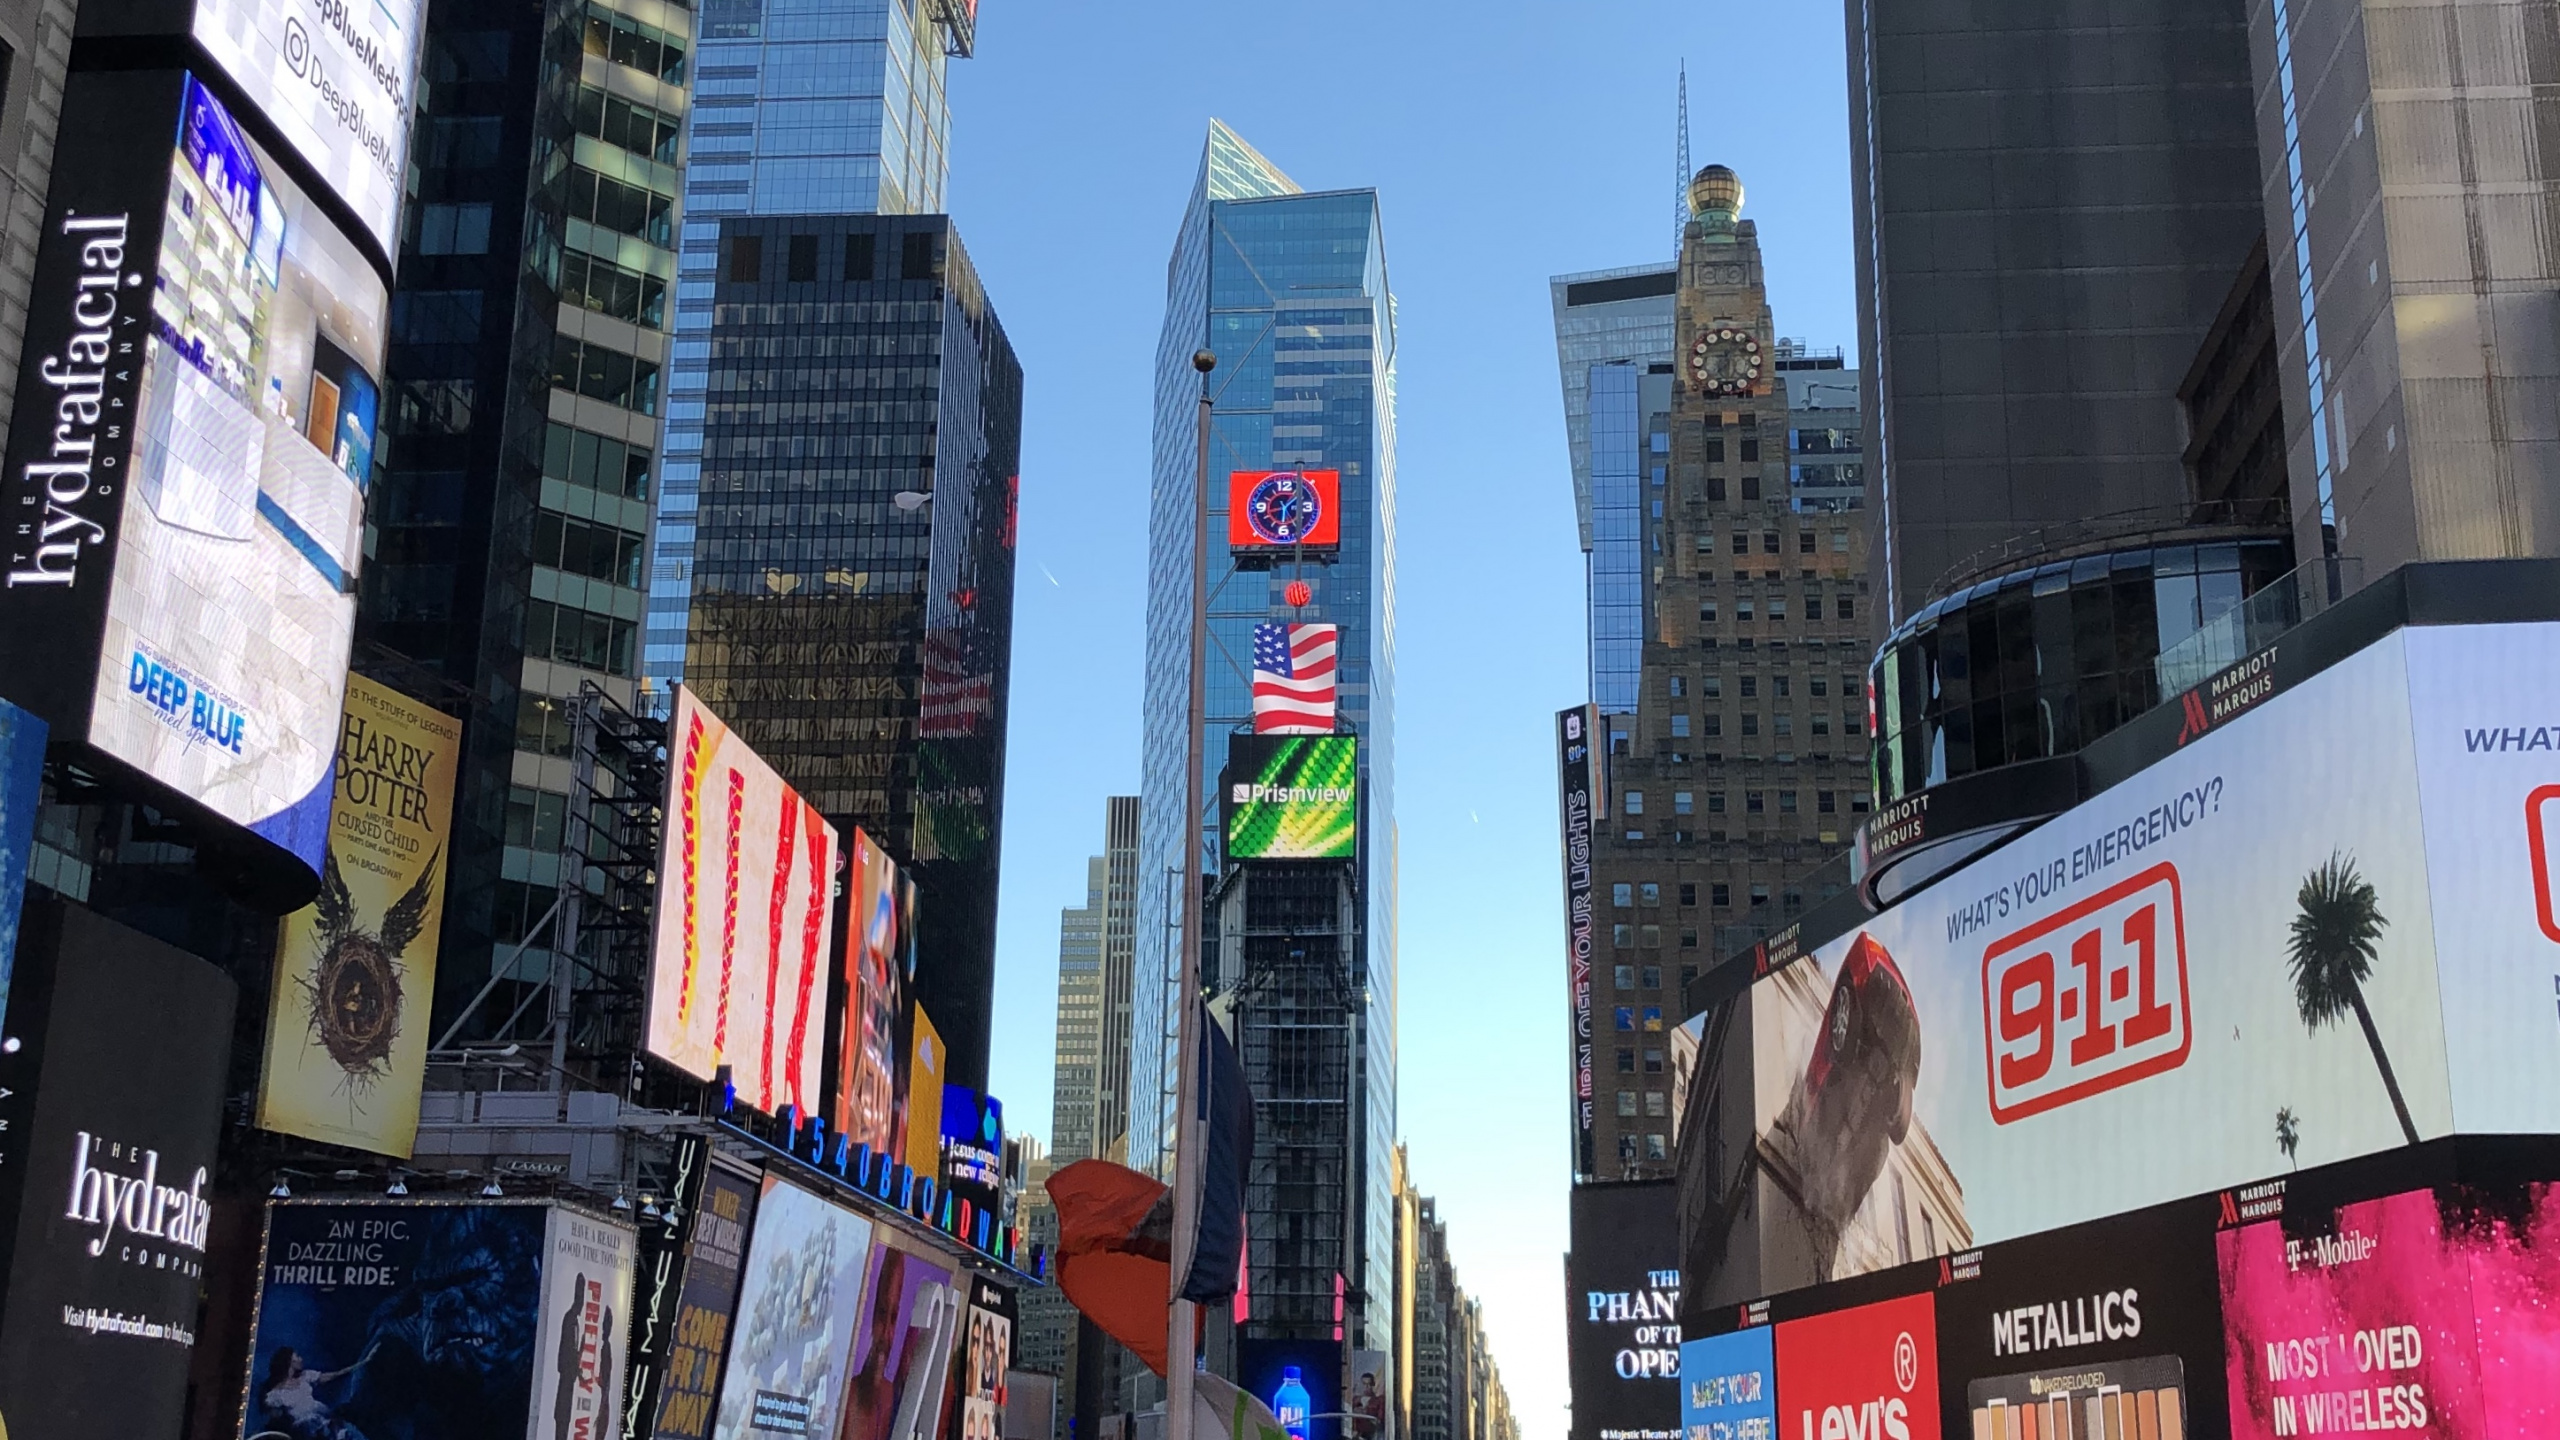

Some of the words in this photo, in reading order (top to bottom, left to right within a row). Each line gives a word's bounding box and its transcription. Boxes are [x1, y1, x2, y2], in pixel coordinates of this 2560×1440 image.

[7, 211, 142, 588] hydrafacial
[100, 316, 137, 495] COMPANY
[1277, 481, 1292, 491] 12
[1256, 502, 1266, 513] 9
[1303, 502, 1313, 512] 3
[13, 496, 36, 562] THE
[1279, 525, 1289, 535] 6
[2211, 645, 2278, 697] MARRIOTT
[129, 651, 187, 715] DEEP
[191, 689, 245, 755] BLUE
[361, 691, 378, 708] THE
[380, 700, 406, 717] STUFF
[407, 713, 418, 725] OF
[2212, 673, 2273, 720] MARQUIS
[153, 708, 190, 732] med
[182, 726, 208, 756] spa
[341, 712, 435, 788] HARRY
[333, 753, 433, 832] POTTER
[1251, 783, 1350, 803] Prismview
[1869, 794, 1930, 836] MARRIOTT
[337, 811, 381, 840] CURSED
[384, 829, 420, 854] CHILD
[1568, 789, 1591, 890] LIGHTS
[1870, 820, 1923, 857] MARQUIS
[346, 854, 359, 866] ON
[361, 858, 403, 881] BROADWAY
[1946, 886, 2010, 944] WHAT'S
[2013, 858, 2067, 910] YOUR
[2071, 775, 2224, 883] EMERGENCY?
[1573, 891, 1592, 979] YOUR
[1768, 923, 1800, 950] MARRIOTT
[1769, 942, 1798, 966] MARQUIS
[95, 1137, 138, 1162] THE
[511, 1161, 562, 1173] LAMAR
[955, 1162, 977, 1179] new
[2240, 1180, 2286, 1201] MARRIOTT
[879, 1151, 1020, 1265] BROADWAY
[2241, 1199, 2283, 1219] MARQUIS
[362, 1221, 410, 1240] EPIC,
[571, 1221, 589, 1242] HAVE
[591, 1229, 596, 1243] A
[597, 1230, 620, 1250] REALLY
[289, 1242, 383, 1262] DAZZLING
[558, 1238, 581, 1259] GOOD
[583, 1245, 599, 1265] TIME
[600, 1250, 629, 1272] TONIGHT
[1952, 1250, 1983, 1267] MARRIOTT
[274, 1265, 337, 1284] THRILL
[1953, 1264, 1980, 1280] MARQUIS
[64, 1305, 84, 1326] Visit
[86, 1307, 163, 1338] HydraFacial.com
[578, 1280, 602, 1394] PRETTY
[678, 1304, 728, 1351] COME
[1636, 1325, 1660, 1344] OF
[1993, 1287, 2141, 1356] METALLICS
[2266, 1336, 2330, 1382] MOST
[2338, 1325, 2422, 1374] LOVED
[1727, 1371, 1762, 1405] YOUR
[658, 1390, 712, 1437] AWAY
[2273, 1397, 2297, 1436] IN
[2302, 1383, 2428, 1434] WIRELESS
[1609, 1429, 1640, 1440] Majestic
[1640, 1428, 1669, 1440] Theatre
